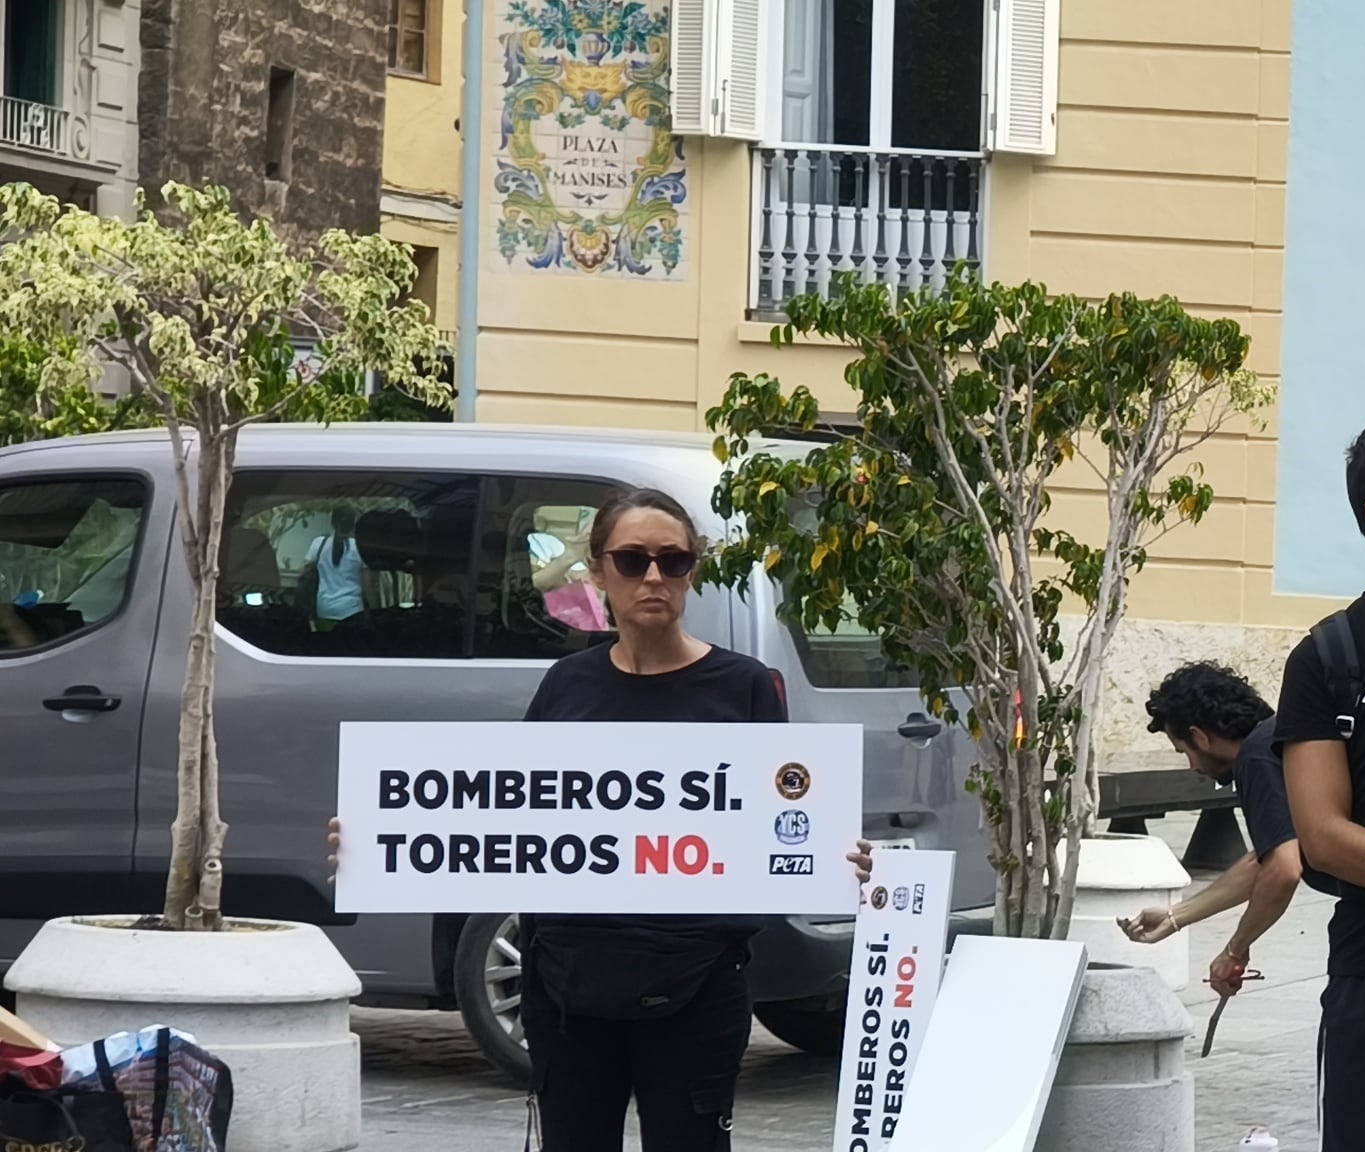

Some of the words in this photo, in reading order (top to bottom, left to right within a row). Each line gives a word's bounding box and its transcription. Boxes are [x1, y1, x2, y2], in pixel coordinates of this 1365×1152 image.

[563, 135, 618, 153] PLAZA
[553, 172, 627, 188] MANISES
[379, 769, 665, 811] BOMBEROS
[679, 762, 742, 811] SÍ.
[780, 813, 806, 835] YCS
[377, 834, 619, 875] TOREROS
[634, 835, 725, 875] NO.
[866, 933, 890, 977] SÍ.
[893, 946, 918, 1008] NO.
[881, 1018, 910, 1141] REROS
